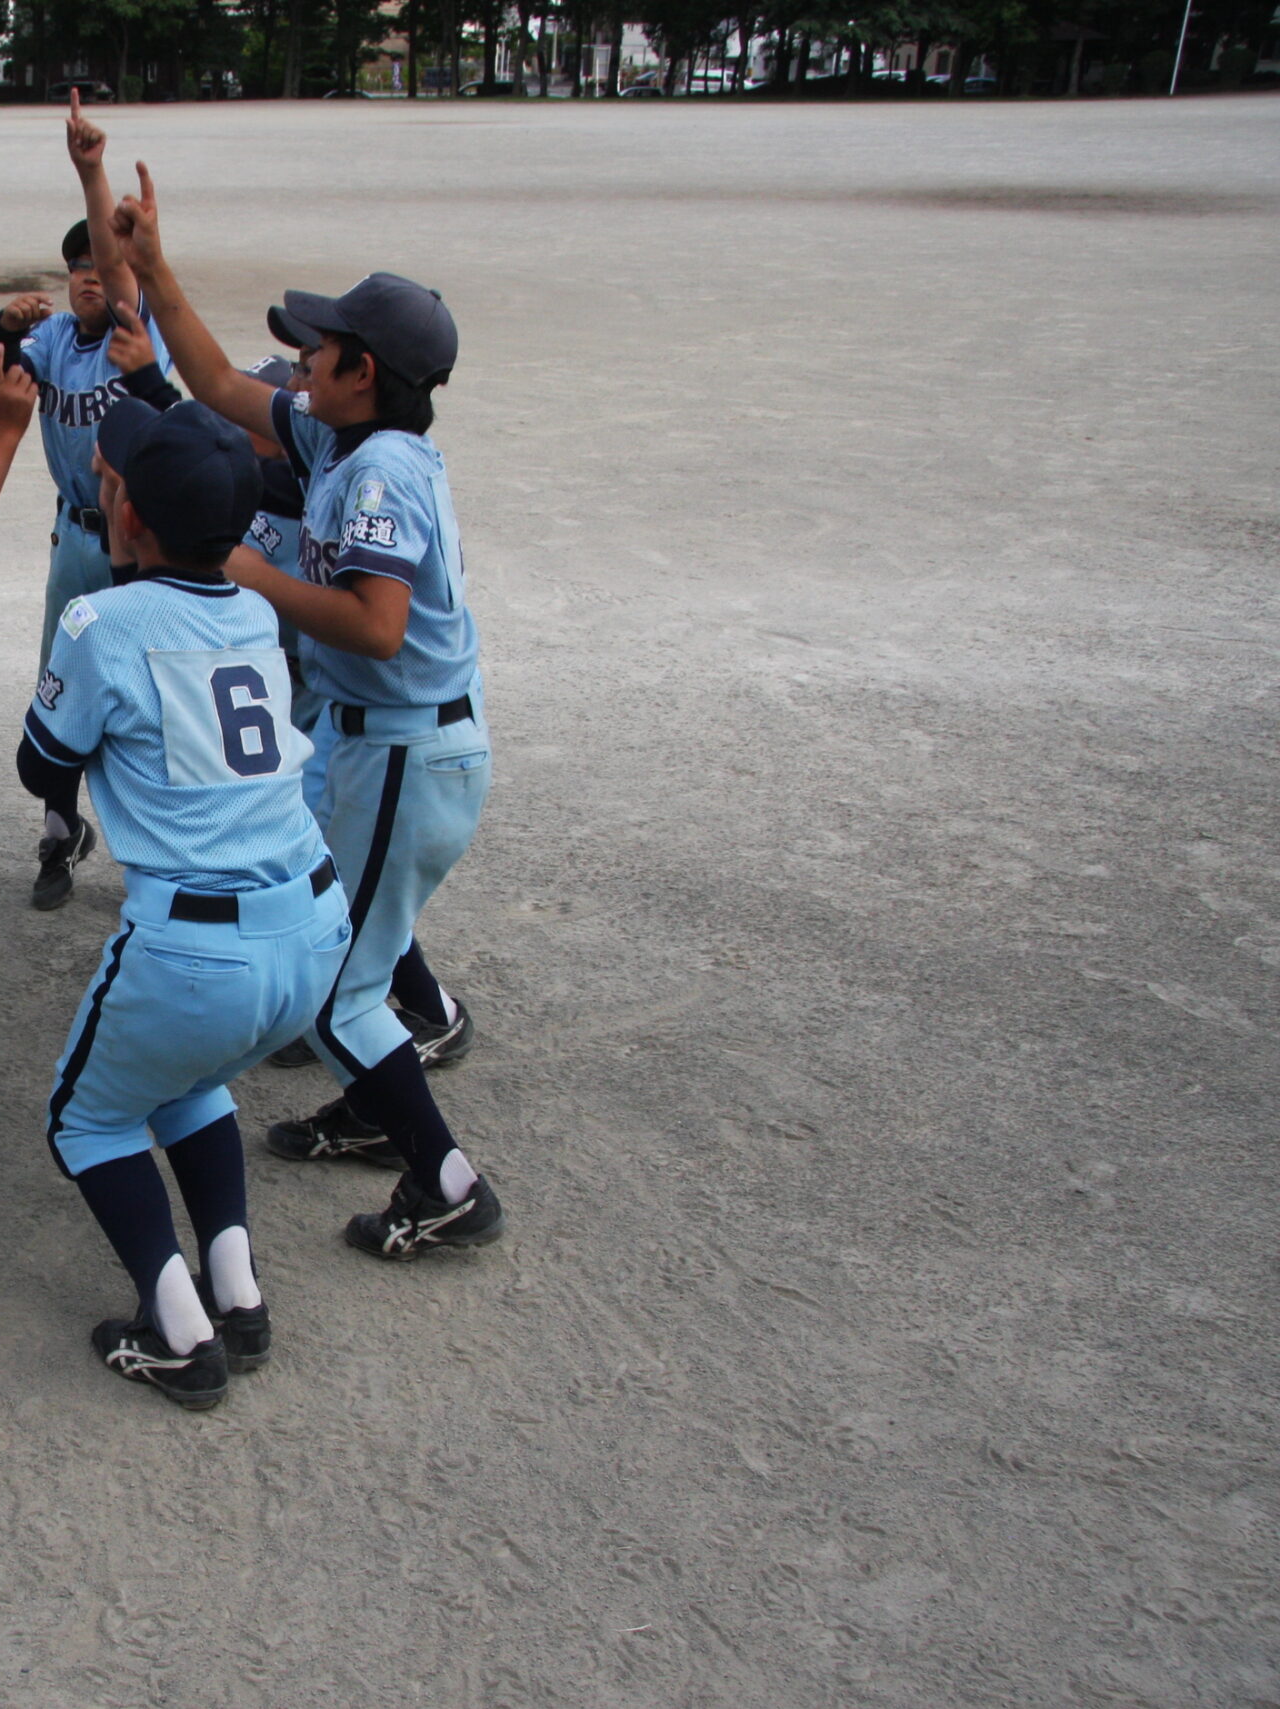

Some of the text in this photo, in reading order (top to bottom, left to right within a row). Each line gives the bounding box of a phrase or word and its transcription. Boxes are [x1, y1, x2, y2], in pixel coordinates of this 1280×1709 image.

[340, 510, 398, 551] 北海道
[208, 662, 283, 779] 6
